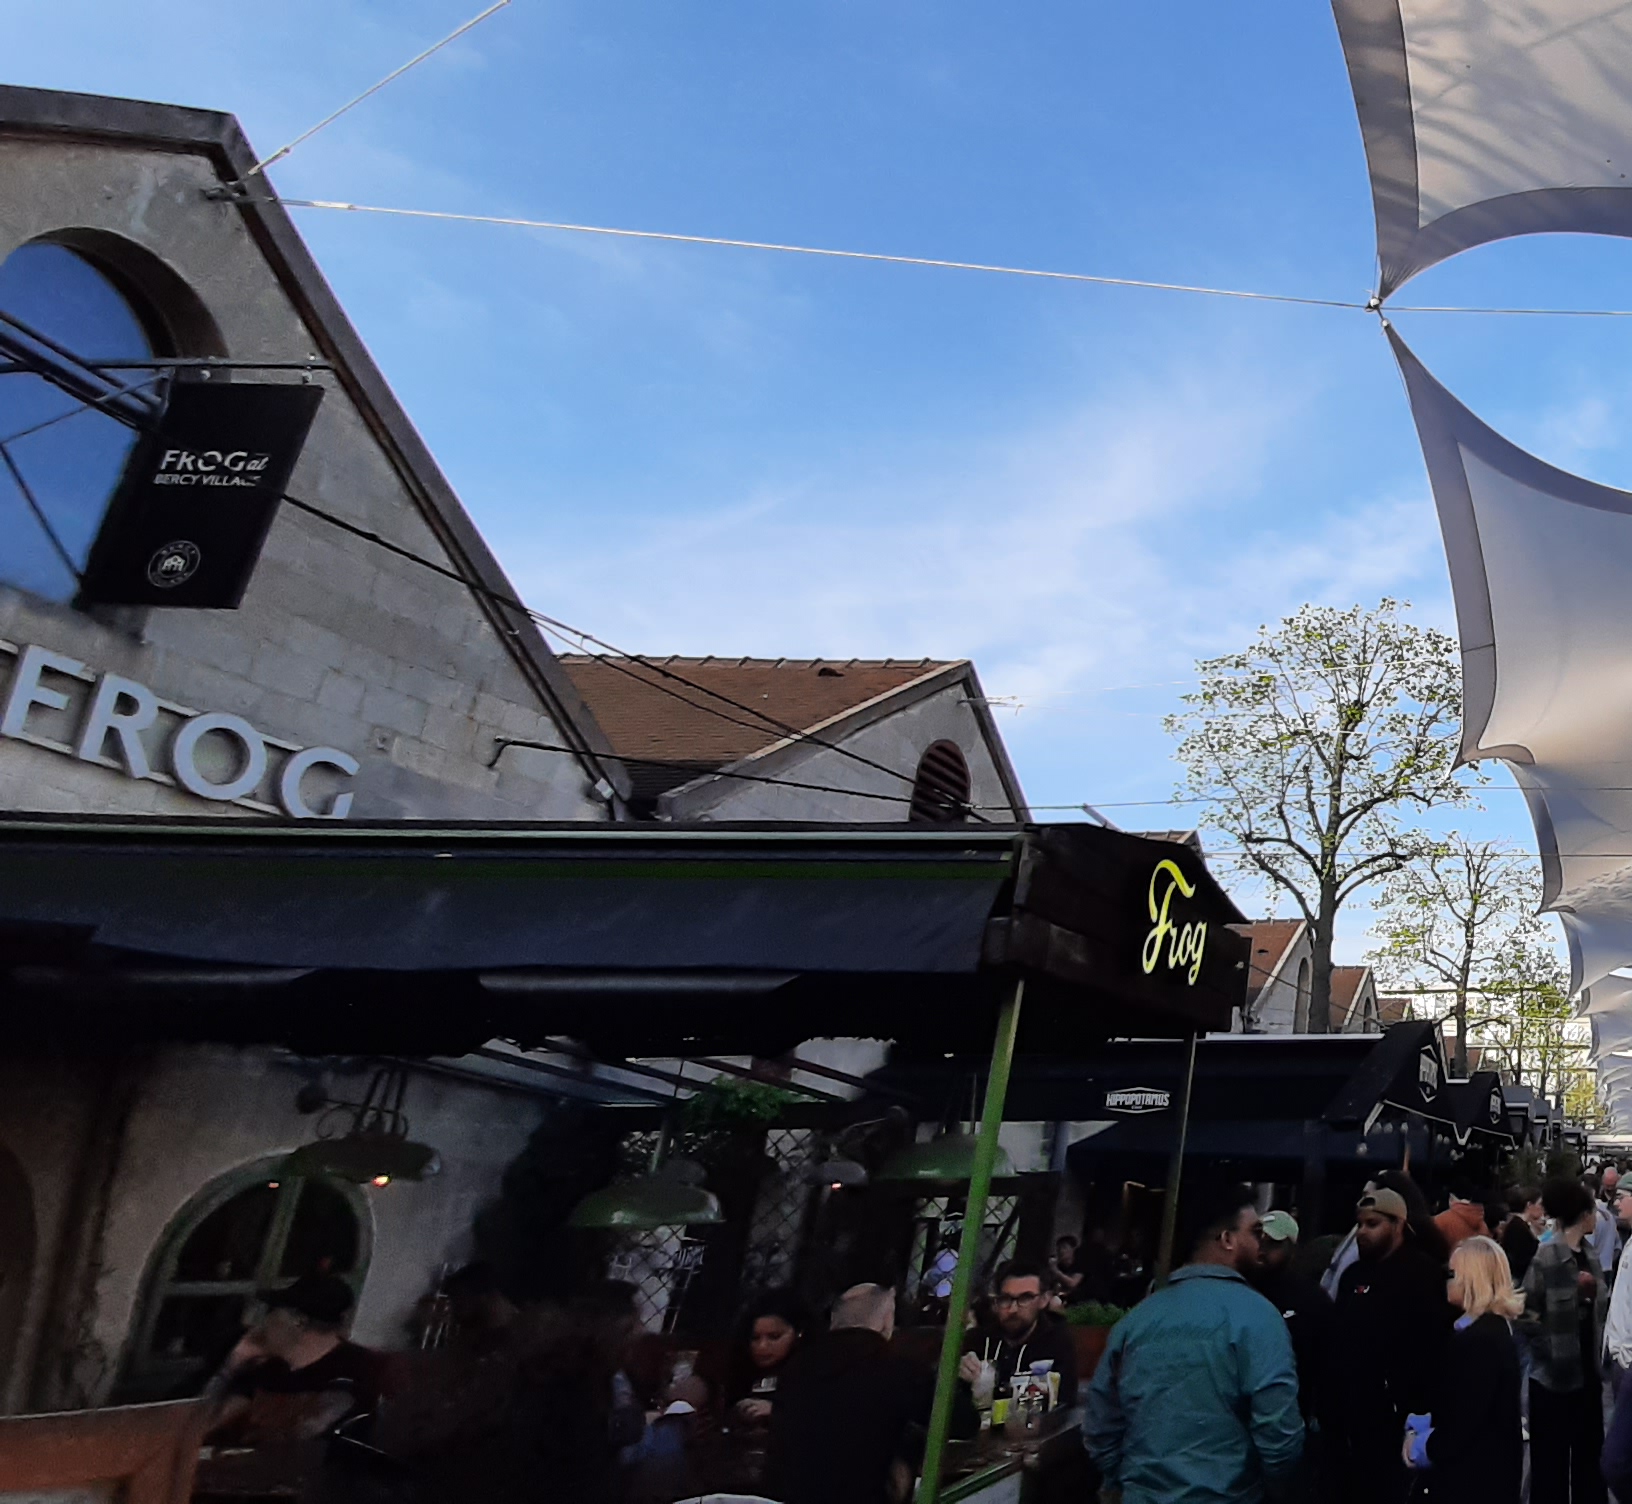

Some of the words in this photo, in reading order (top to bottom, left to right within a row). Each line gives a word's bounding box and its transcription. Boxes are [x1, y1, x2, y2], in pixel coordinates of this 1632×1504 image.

[0, 644, 361, 819] FROG
[1142, 858, 1208, 986] Frog
[1105, 1092, 1171, 1107] HIPPOPOTAMUS
